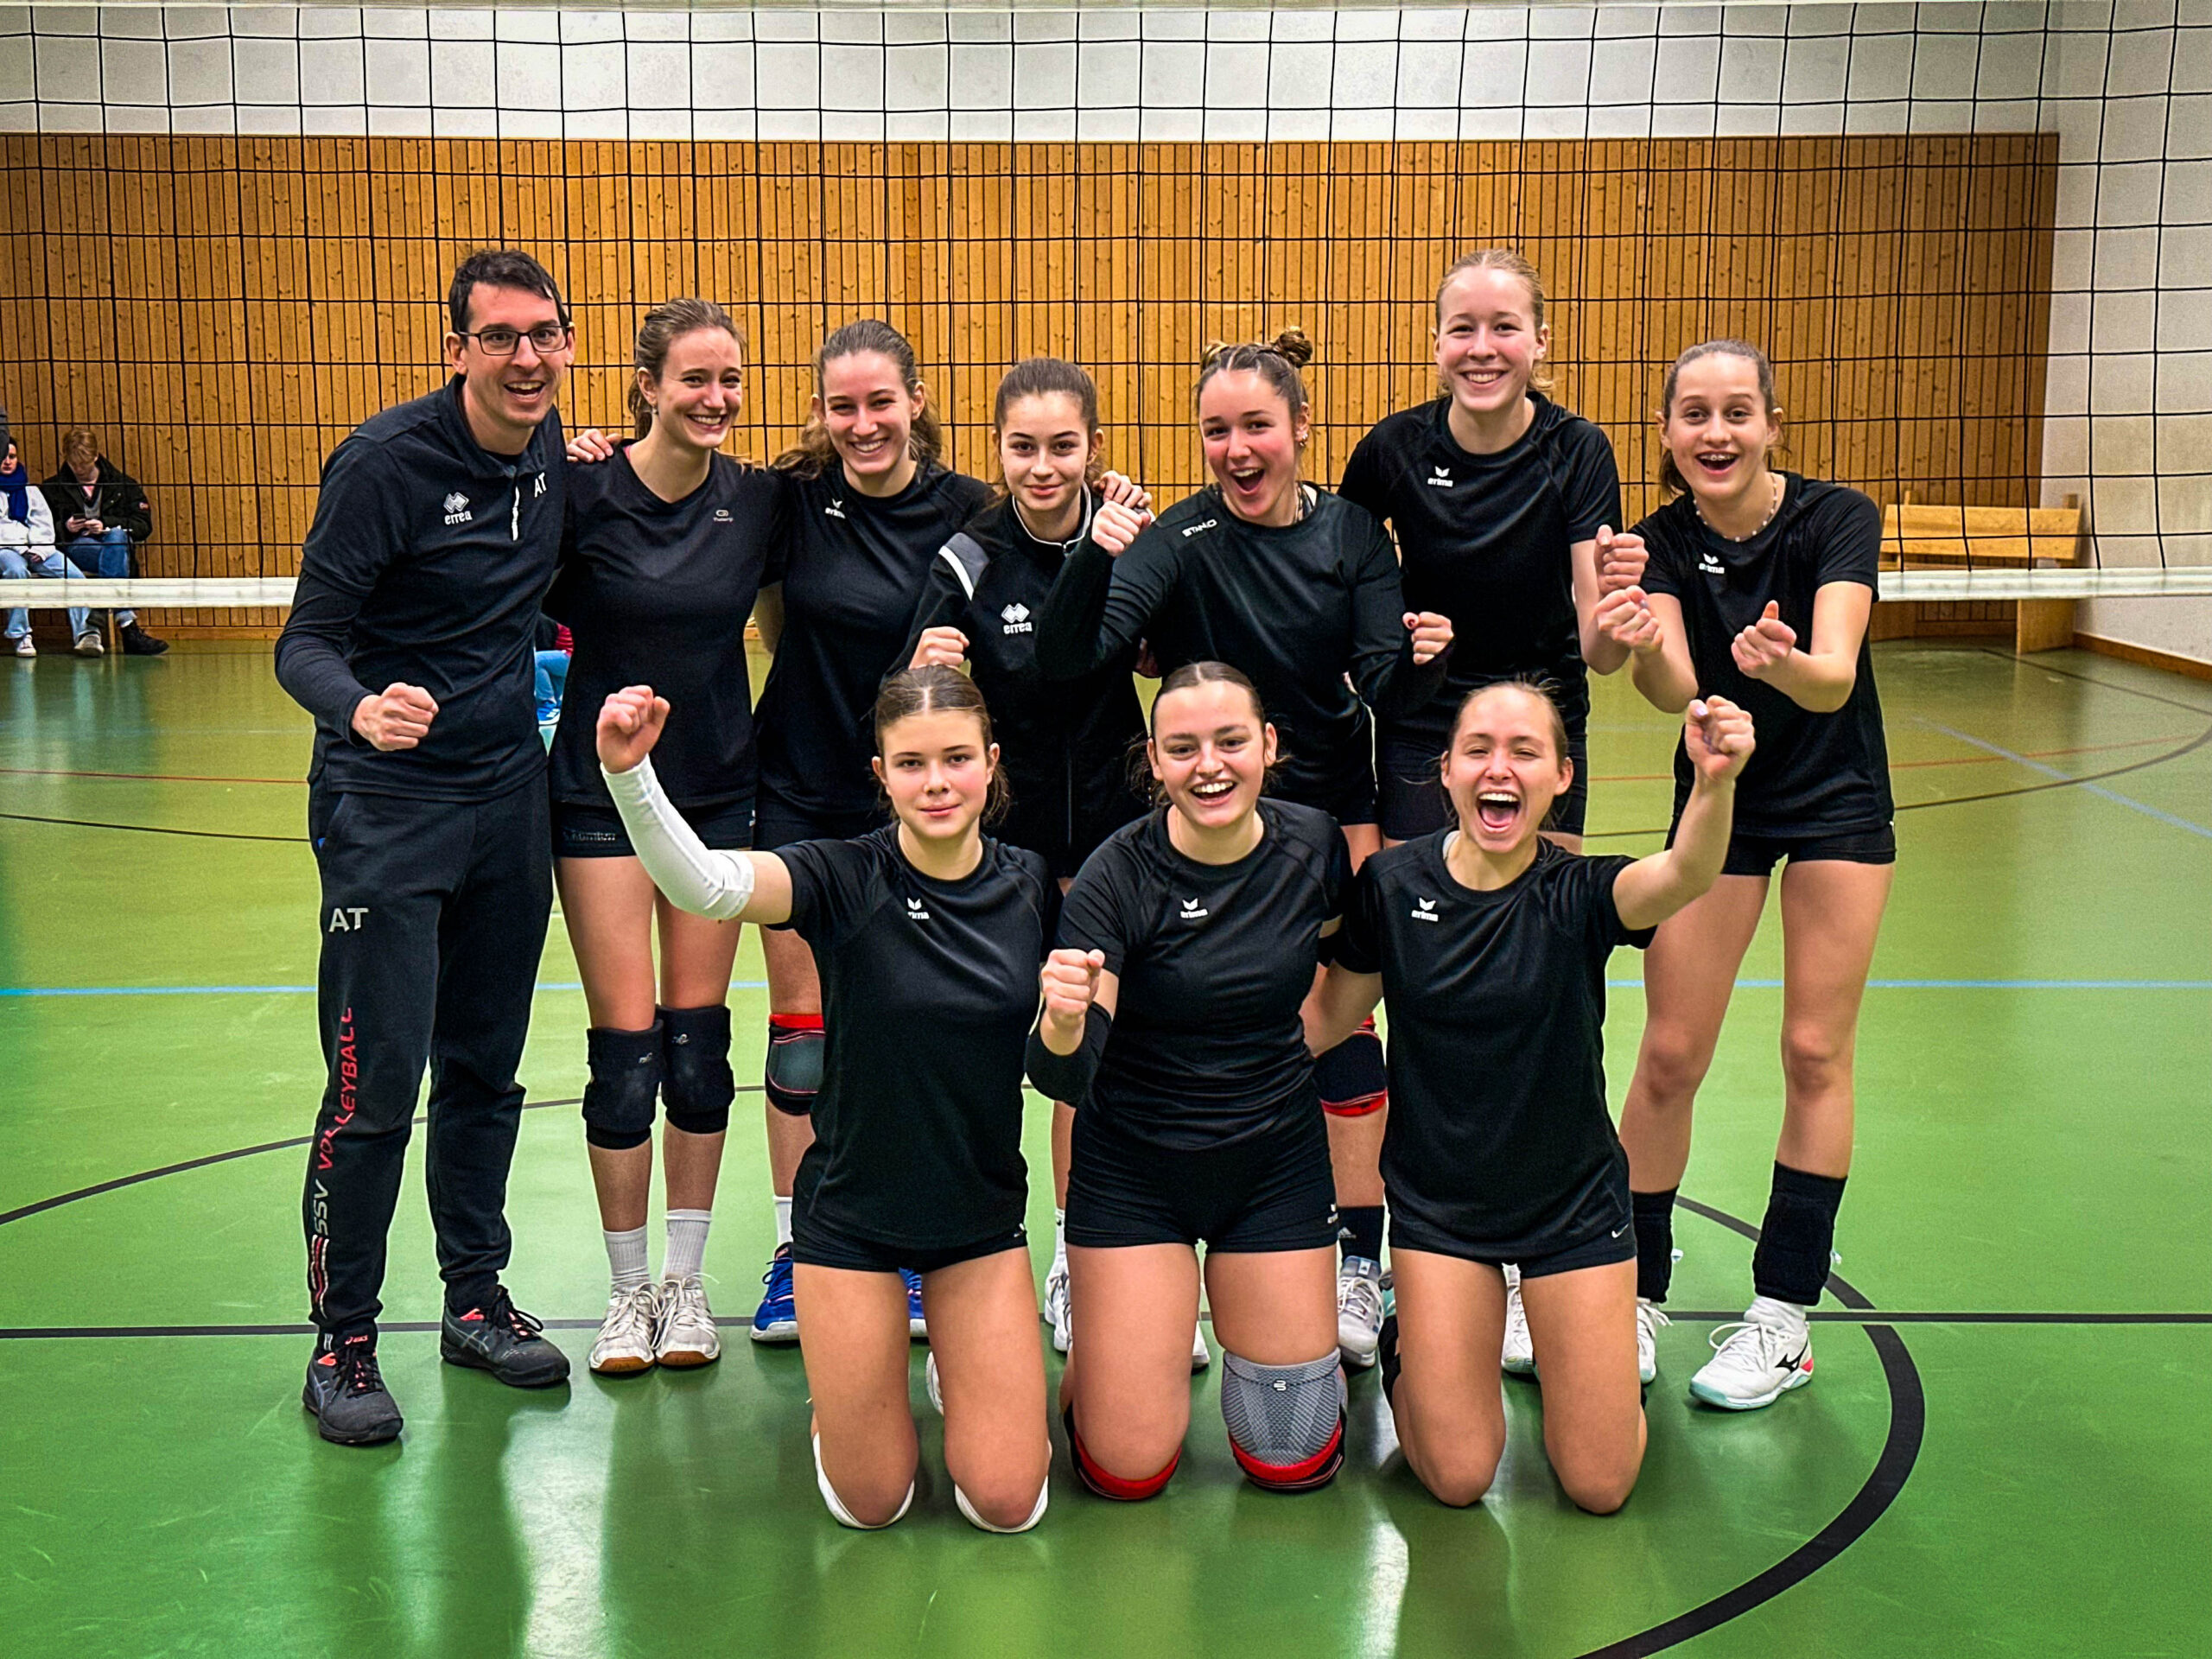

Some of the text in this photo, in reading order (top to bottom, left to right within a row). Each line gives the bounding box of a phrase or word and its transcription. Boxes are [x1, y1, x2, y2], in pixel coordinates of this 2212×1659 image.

[534, 472, 547, 499] AT
[328, 907, 370, 932] AT
[313, 1007, 358, 1236] SSV VOLLEYBALL
